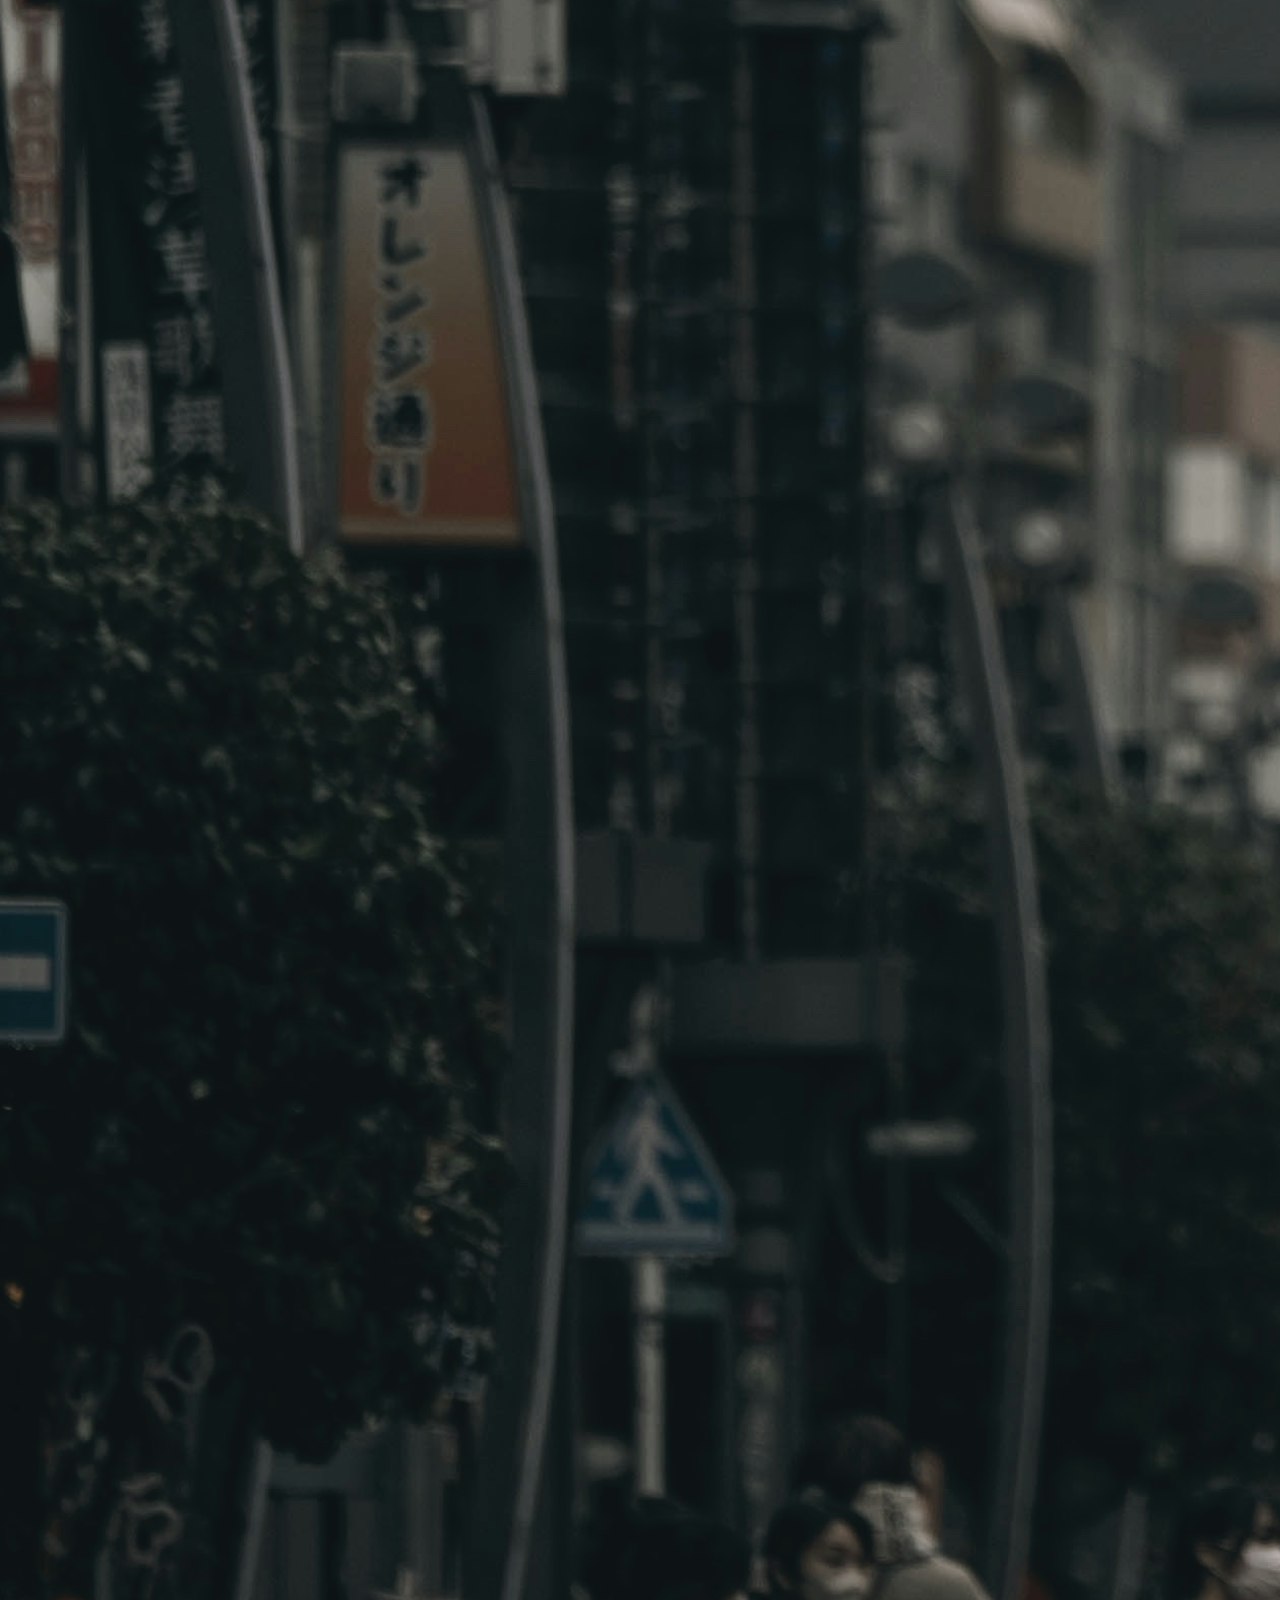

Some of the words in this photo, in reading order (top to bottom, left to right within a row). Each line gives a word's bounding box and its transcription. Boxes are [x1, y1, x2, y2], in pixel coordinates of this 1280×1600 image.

[371, 157, 428, 513] オレンジ通り
